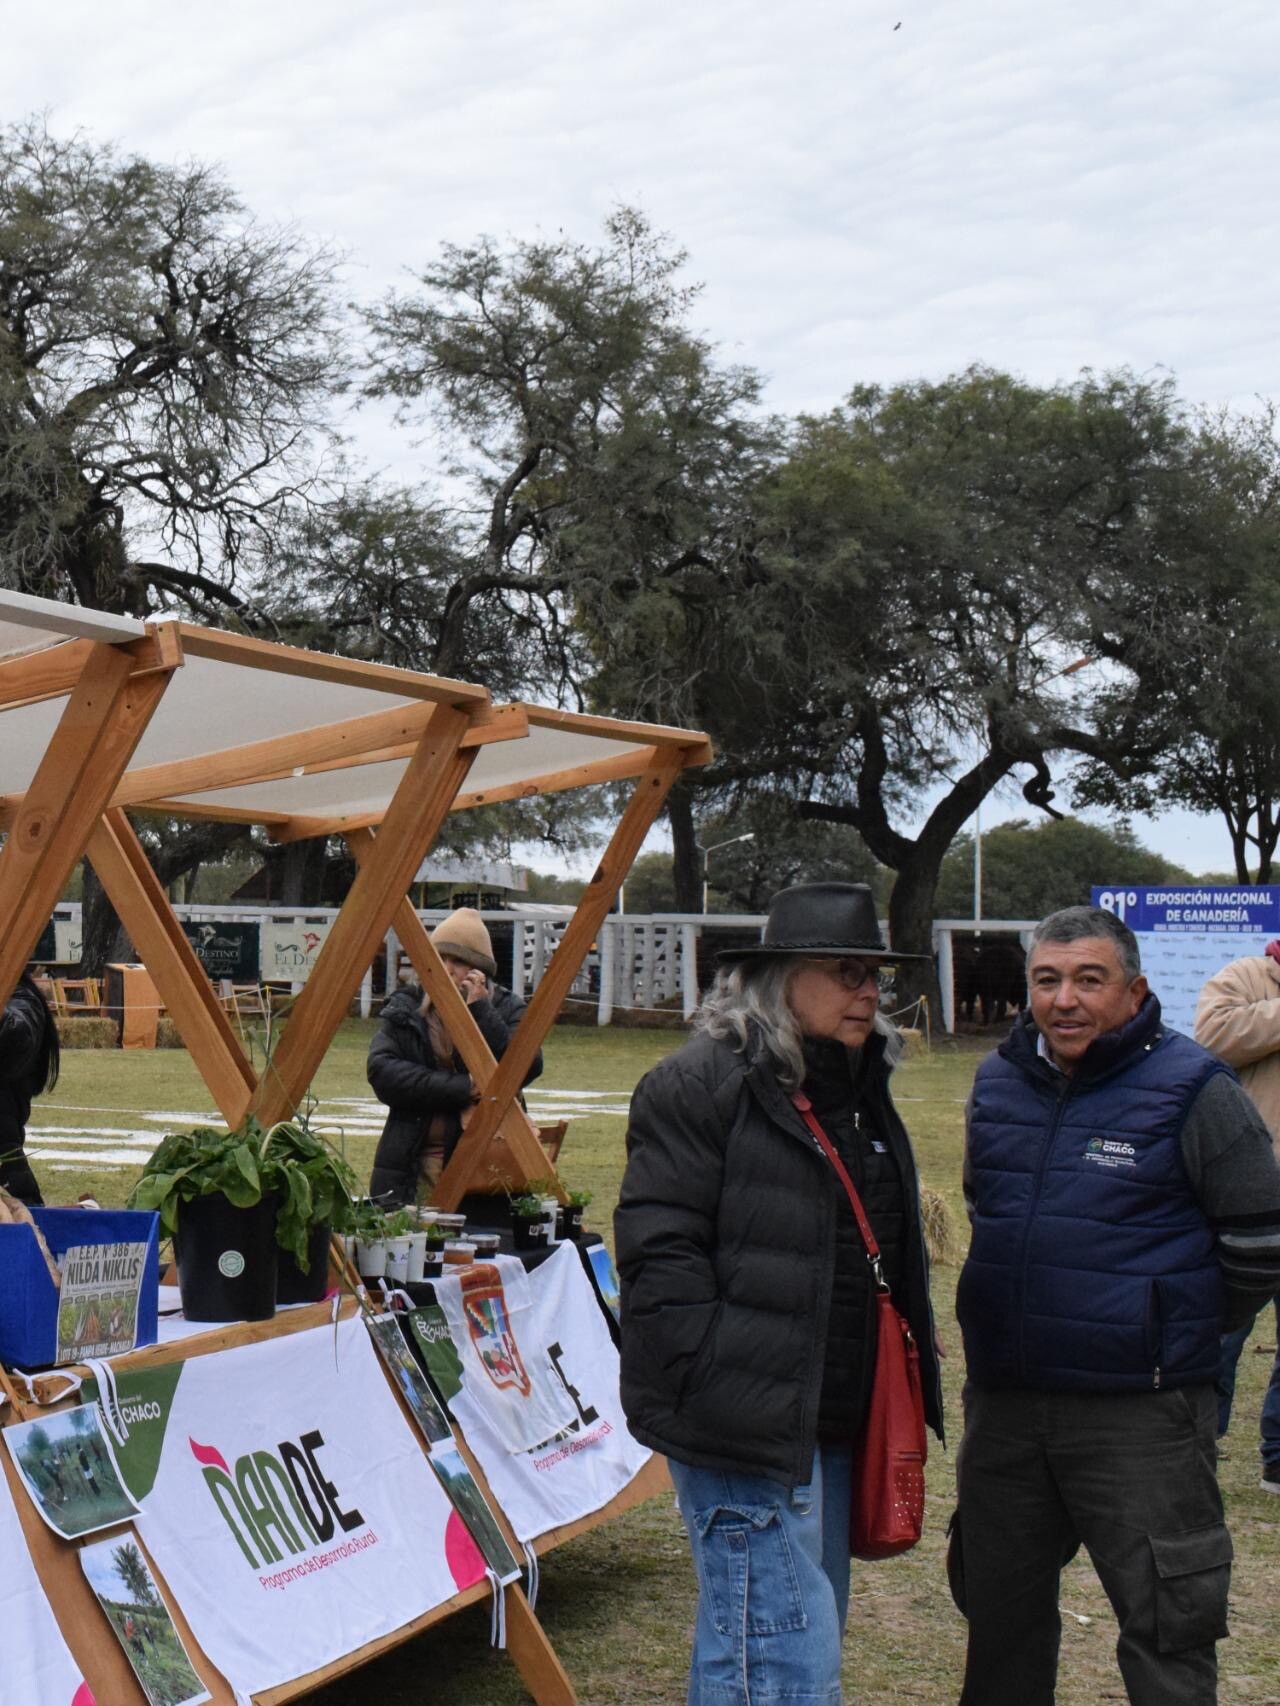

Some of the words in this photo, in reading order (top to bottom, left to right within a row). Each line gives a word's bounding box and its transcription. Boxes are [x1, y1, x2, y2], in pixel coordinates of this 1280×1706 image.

[1146, 890, 1211, 905] EXPOSICIÓN
[1214, 892, 1273, 905] NACIONAL
[1166, 910, 1181, 922] DE
[1183, 907, 1249, 922] GANADERÍA
[1103, 1144, 1135, 1155] CHACO
[67, 1262, 99, 1285] NILDA
[102, 1258, 140, 1281] NIKLIS
[122, 1401, 161, 1424] CHACO
[258, 1564, 307, 1590] Programa
[304, 1558, 317, 1572] de
[312, 1542, 357, 1569] Desarrollo
[352, 1529, 378, 1552] Rural
